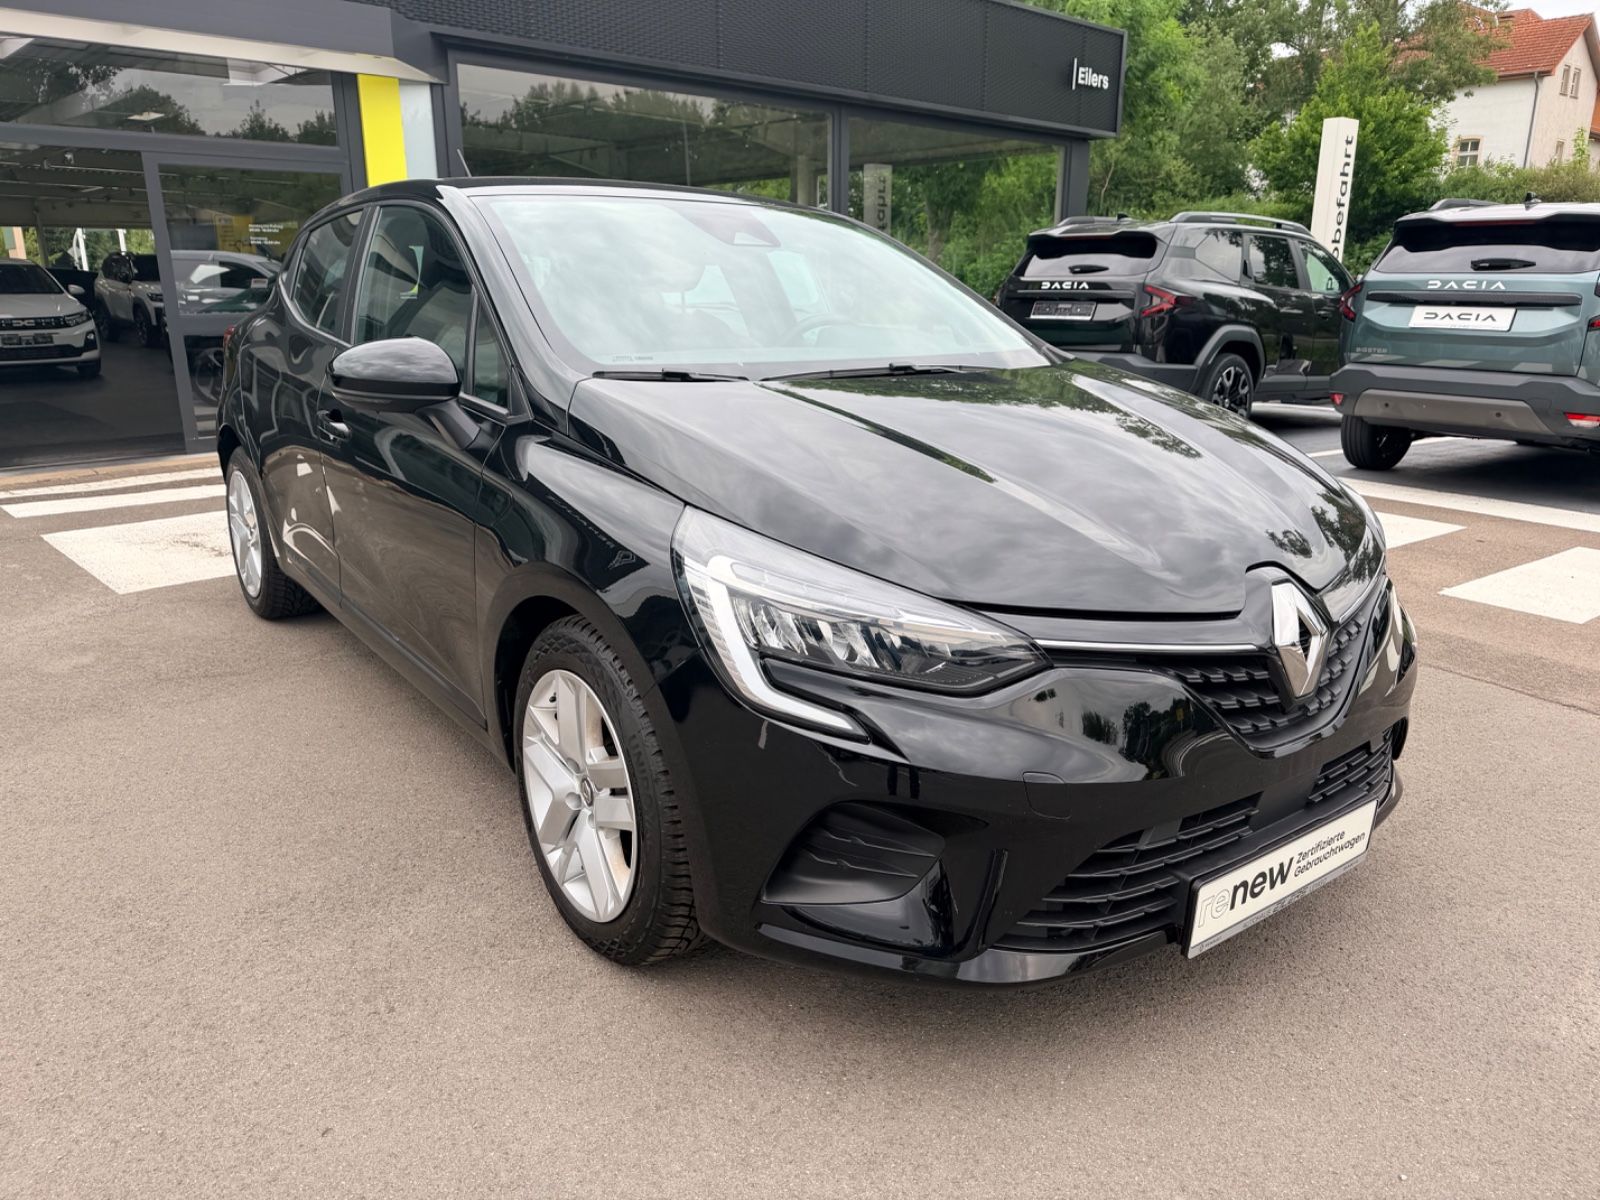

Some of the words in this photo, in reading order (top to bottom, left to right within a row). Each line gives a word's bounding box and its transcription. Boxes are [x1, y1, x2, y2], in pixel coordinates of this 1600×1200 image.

[1078, 66, 1109, 90] Eilers
[1041, 281, 1089, 290] DACIA
[1427, 280, 1506, 290] DACIA
[1423, 312, 1497, 322] DACIA
[1294, 832, 1366, 877] Gebrauchtwagen
[1296, 831, 1346, 864] Zertifizierte
[1197, 857, 1295, 929] renew
